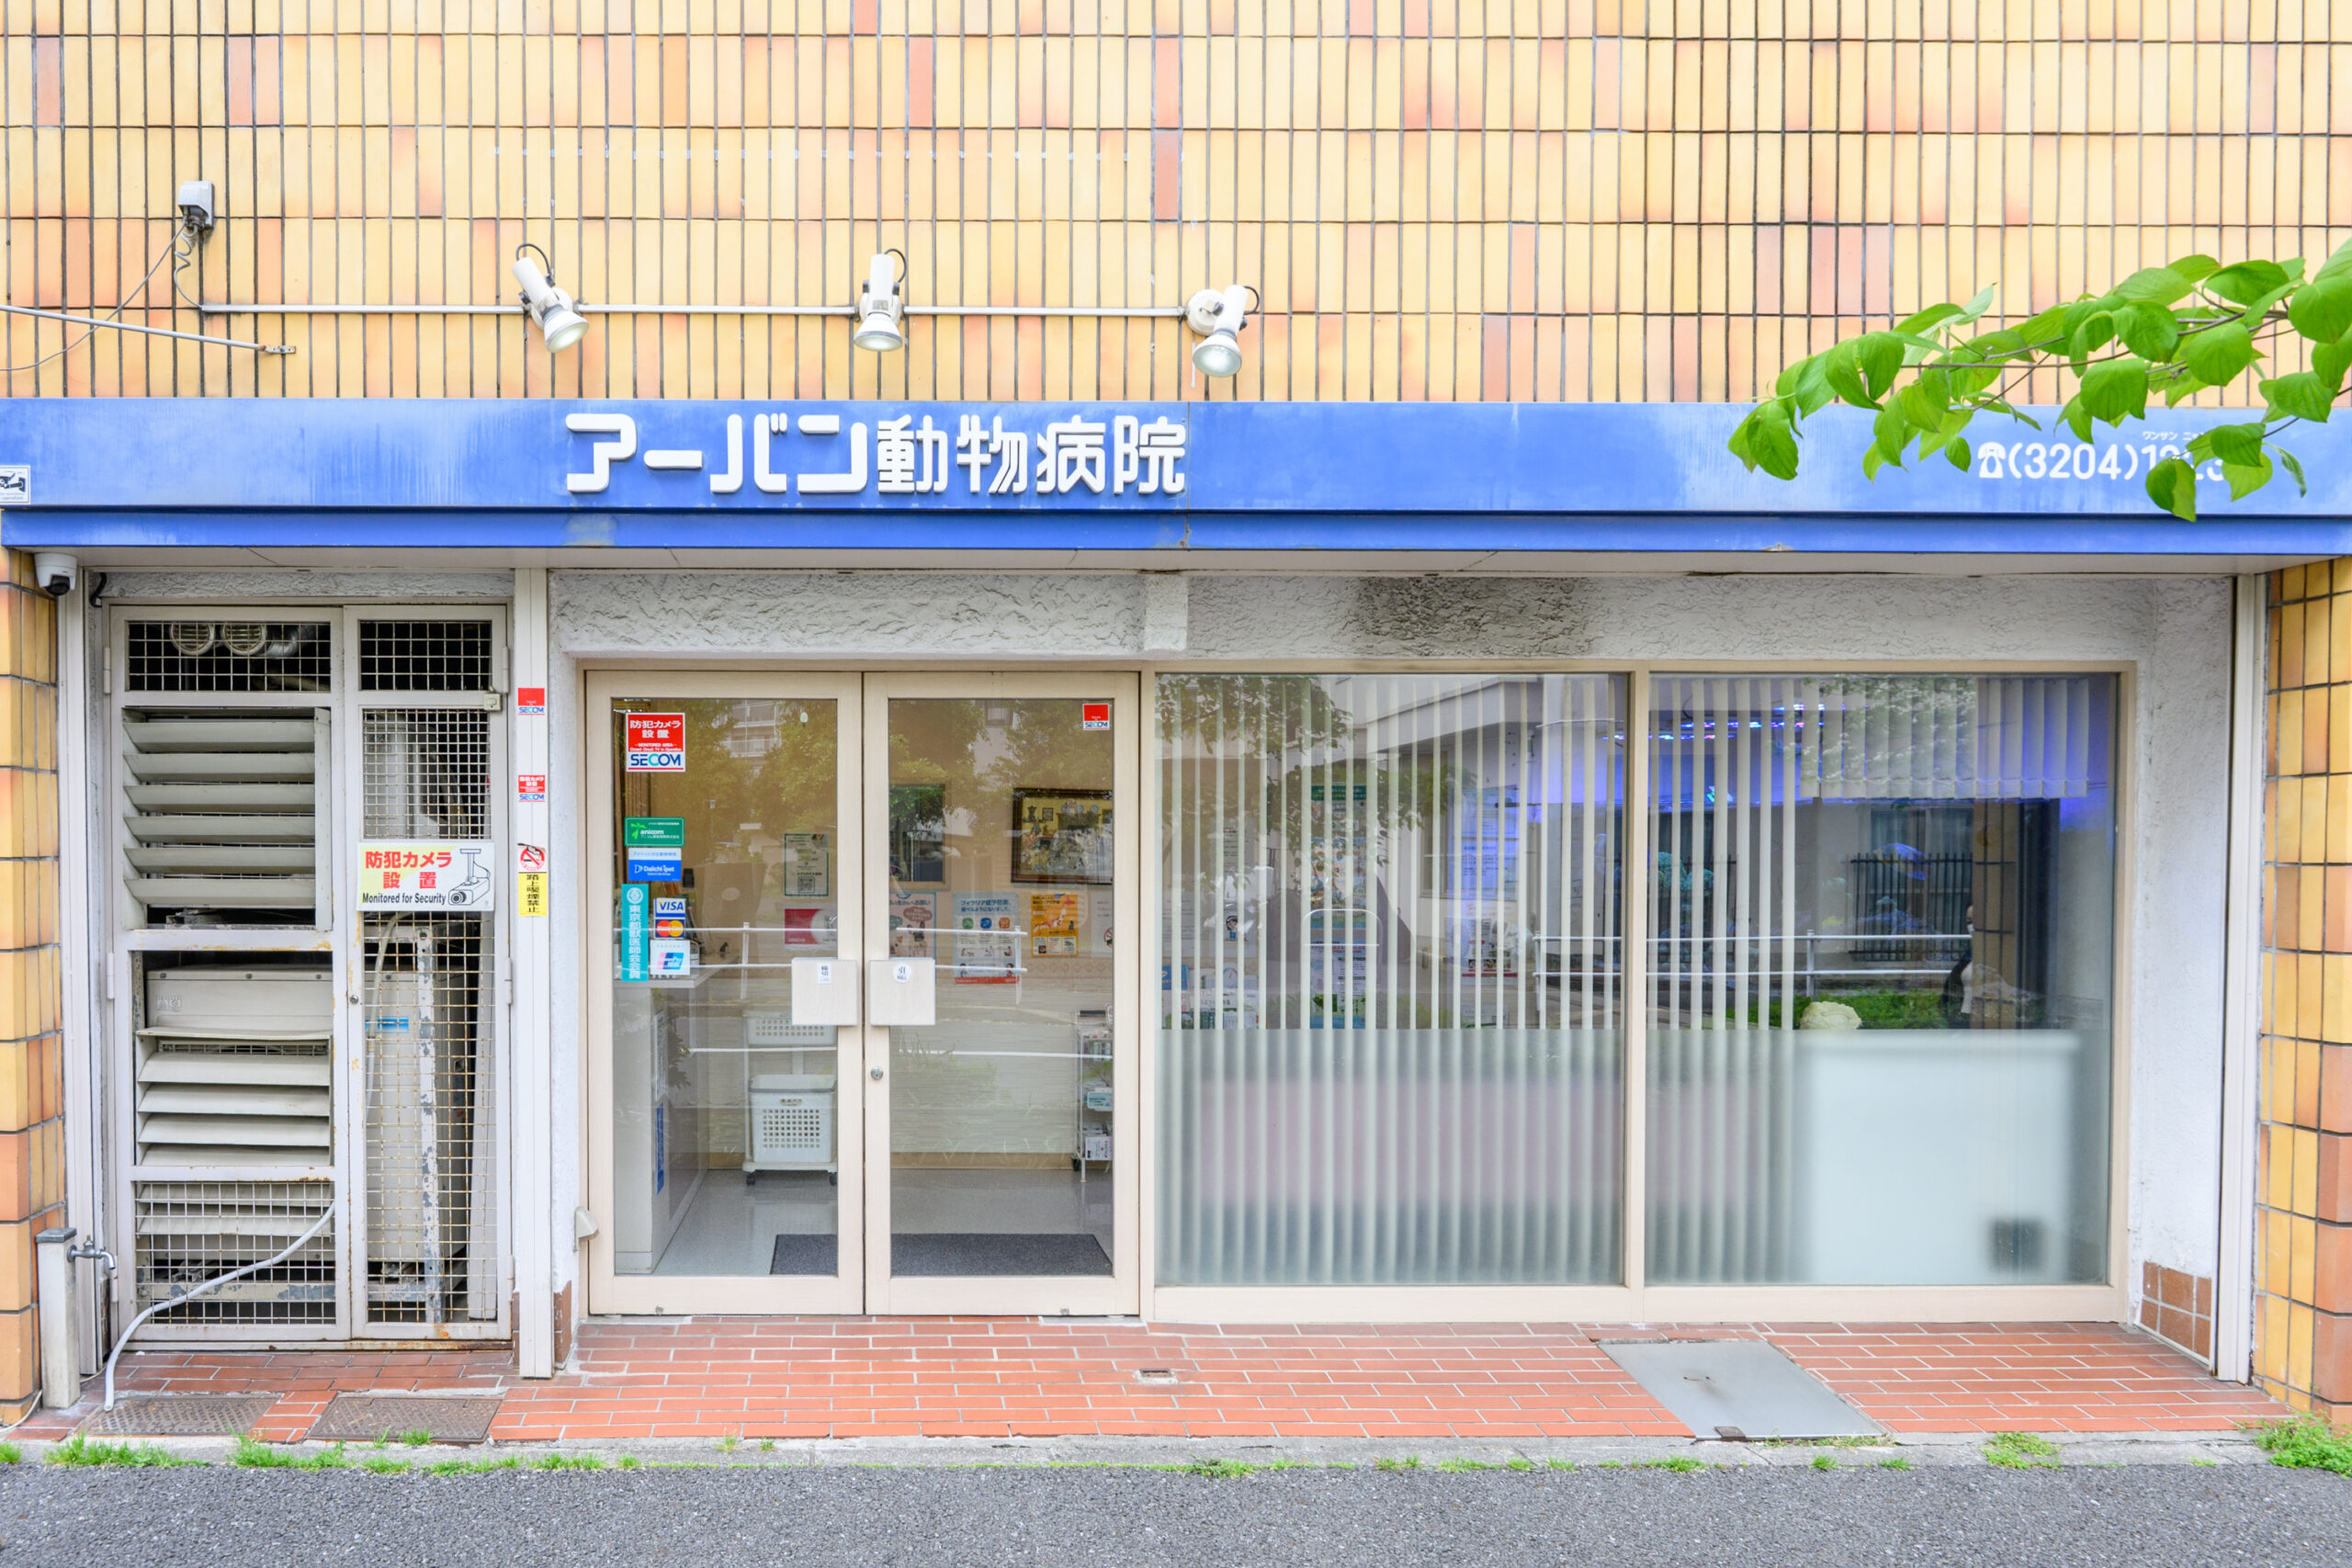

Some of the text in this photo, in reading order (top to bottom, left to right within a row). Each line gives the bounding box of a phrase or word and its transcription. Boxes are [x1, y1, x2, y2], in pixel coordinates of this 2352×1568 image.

[2143, 431, 2178, 441] ワンサン
[565, 412, 1186, 494] アーバン動物病院
[629, 720, 682, 729] 防犯カメラ
[630, 753, 682, 766] SECOM
[365, 851, 452, 869] 防犯カメラ
[383, 872, 436, 889] 設置
[362, 893, 447, 906] Monitored for Security
[660, 901, 684, 911] VISA
